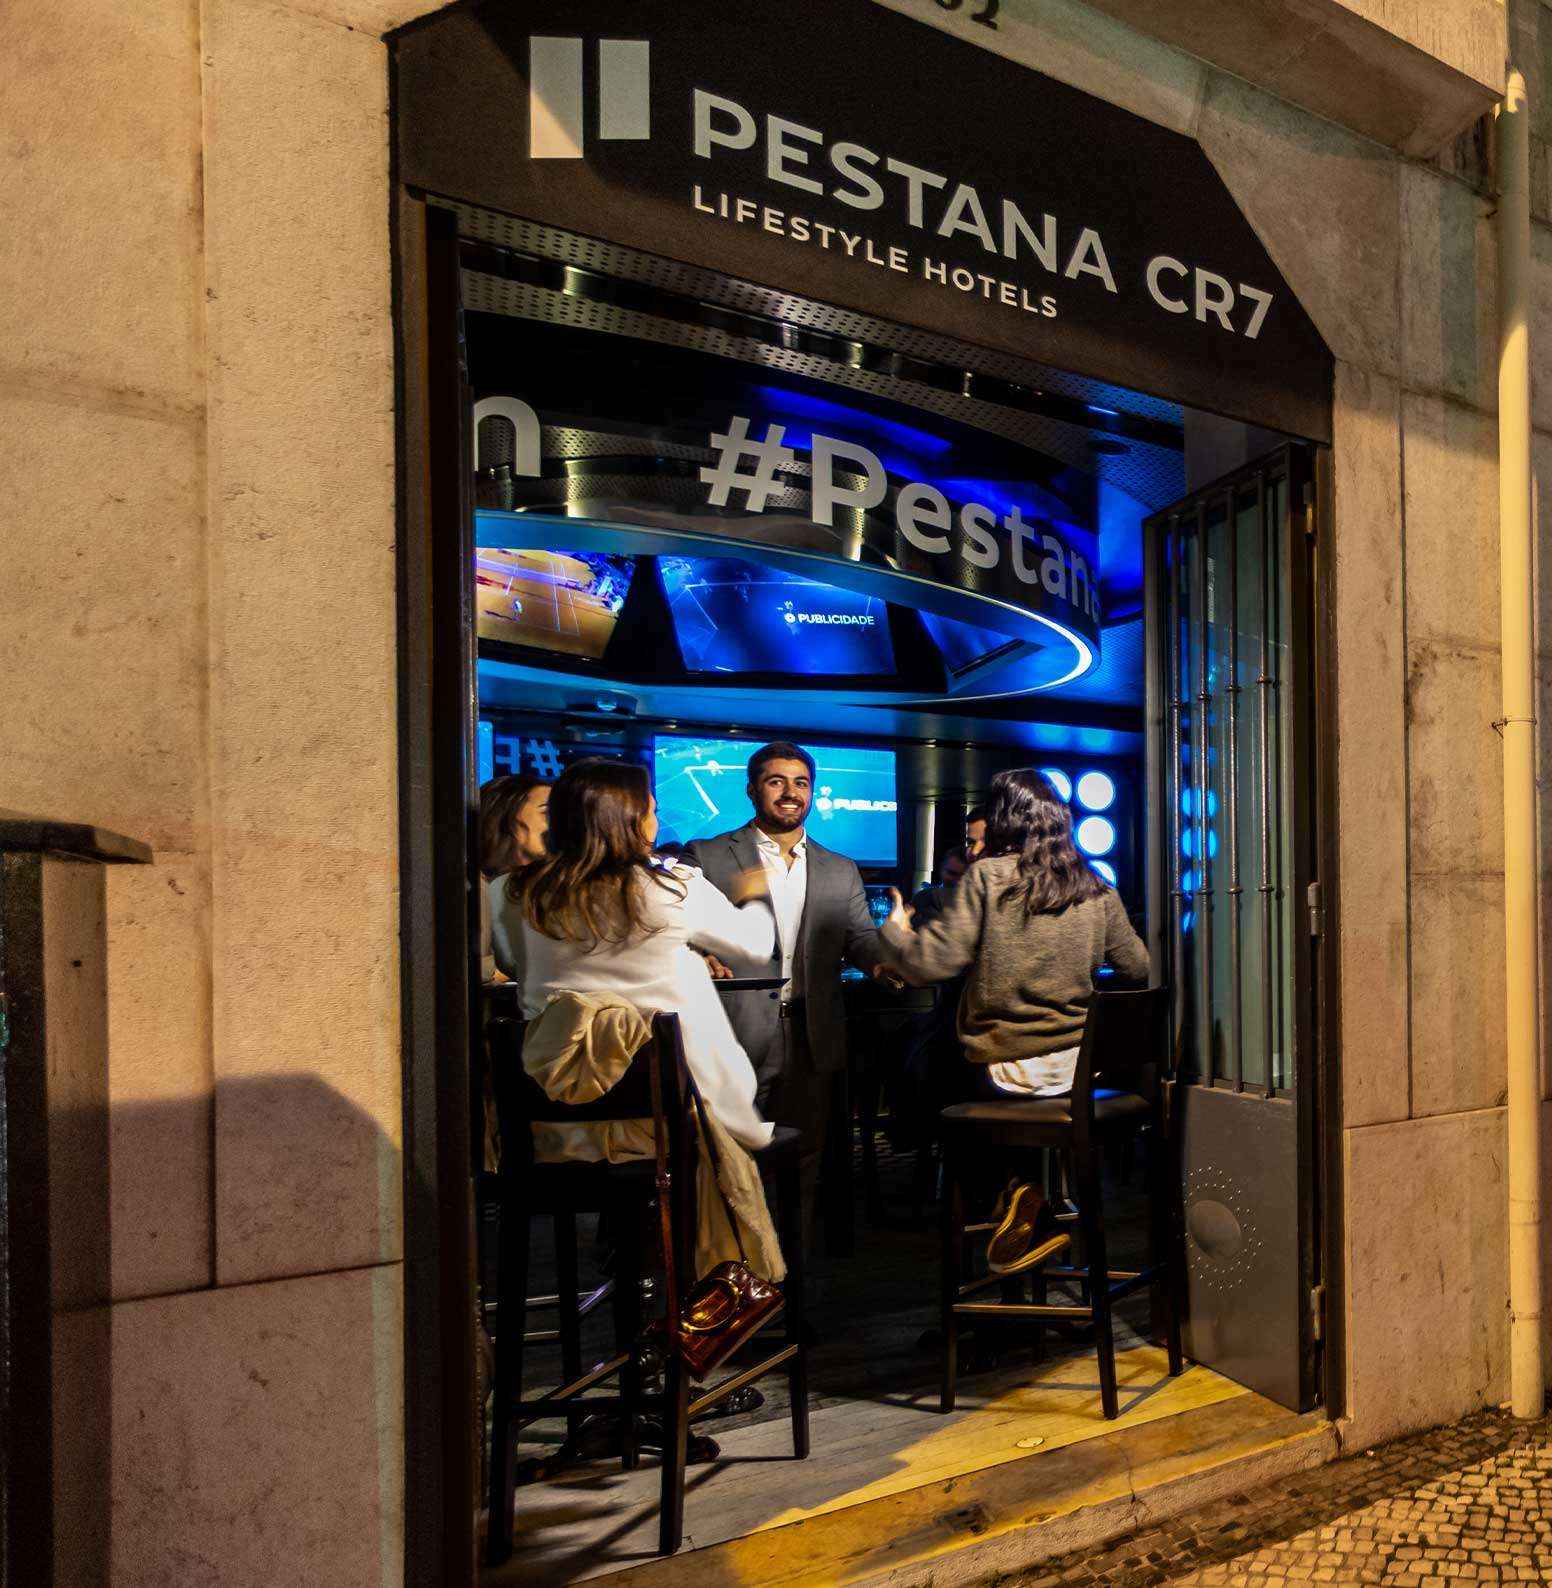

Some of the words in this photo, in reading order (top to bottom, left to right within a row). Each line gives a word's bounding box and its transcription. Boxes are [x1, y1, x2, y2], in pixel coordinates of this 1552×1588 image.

[693, 88, 1119, 294] PESTANA
[1145, 255, 1275, 340] CR7
[693, 185, 910, 273] LIFESTYLE
[923, 257, 1059, 319] HOTELS
[798, 613, 875, 626] PUBLICIDADE
